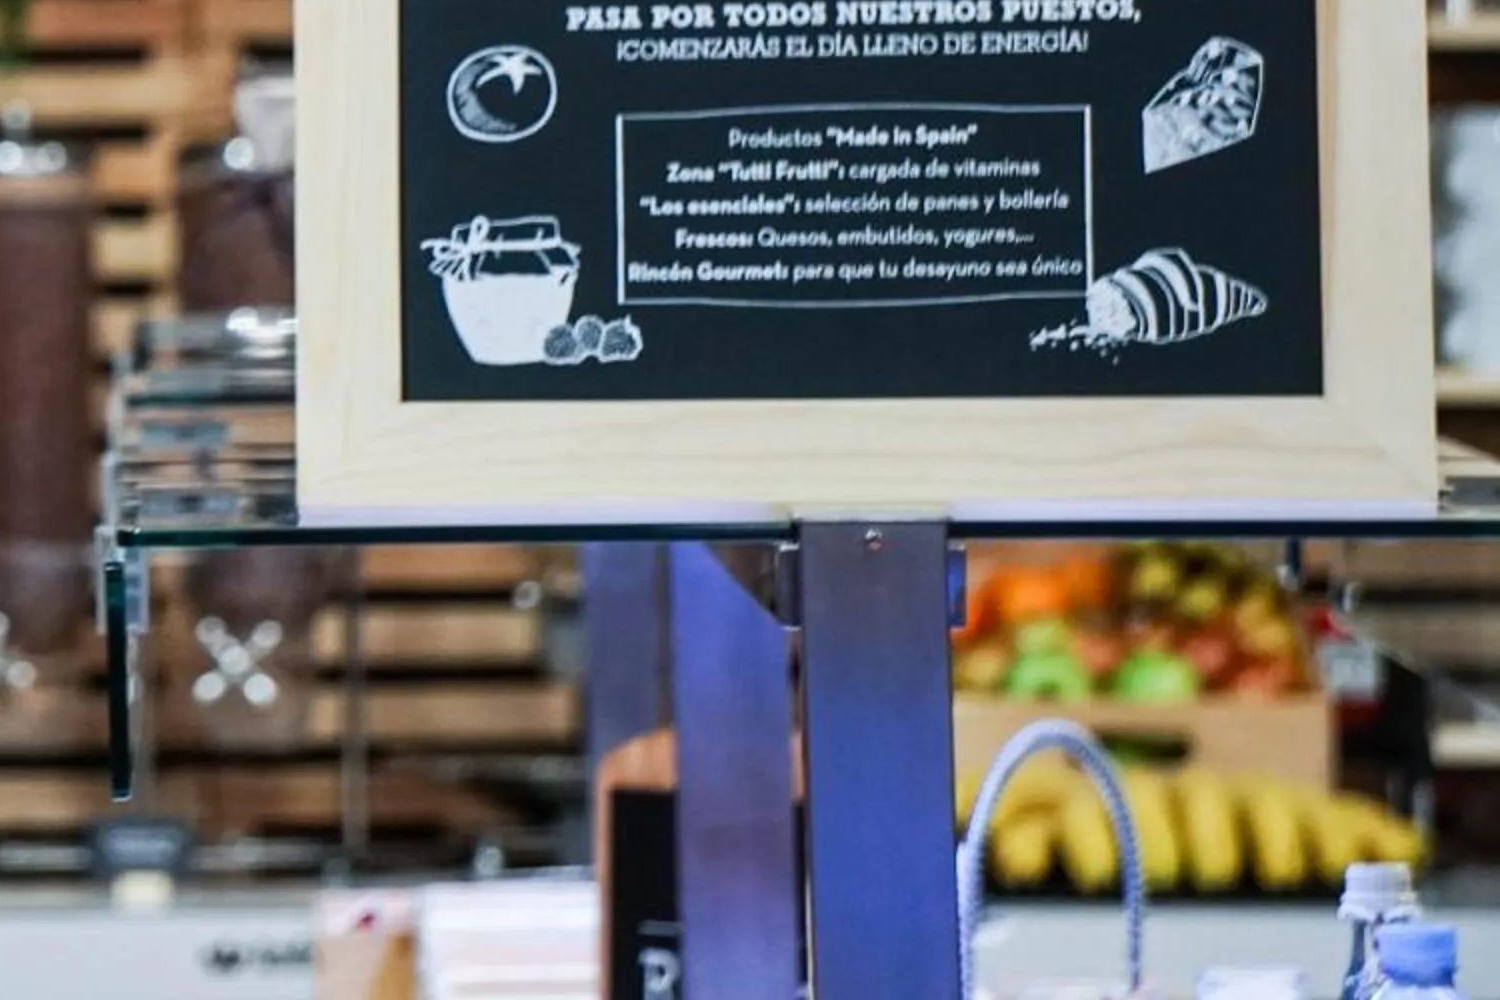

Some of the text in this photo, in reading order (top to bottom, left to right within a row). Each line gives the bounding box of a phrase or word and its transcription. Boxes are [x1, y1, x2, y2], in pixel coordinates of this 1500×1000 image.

[565, 5, 643, 32] PASA
[650, 3, 716, 30] POR
[722, 0, 828, 28] TODOS
[785, 35, 815, 58] EL
[817, 30, 859, 57] DÍA
[862, 32, 939, 57] LLENO
[943, 31, 977, 55] DE
[728, 127, 823, 149] Productos
[666, 161, 715, 183] Zona
[848, 157, 921, 184] cargada
[924, 157, 950, 178] de
[953, 158, 1041, 177] vitaminas
[804, 191, 891, 213] selección
[894, 191, 920, 212] de
[923, 195, 980, 215] panes
[983, 195, 995, 214] y
[999, 188, 1070, 210] bollería
[757, 226, 833, 248] Quesos,
[836, 223, 939, 246] embutidos,
[627, 261, 694, 283] Rincón
[792, 264, 835, 284] para
[837, 263, 875, 283] que
[878, 259, 899, 279] tu
[902, 257, 992, 281] desayuno
[995, 260, 1028, 277] sea
[1031, 255, 1083, 276] único
